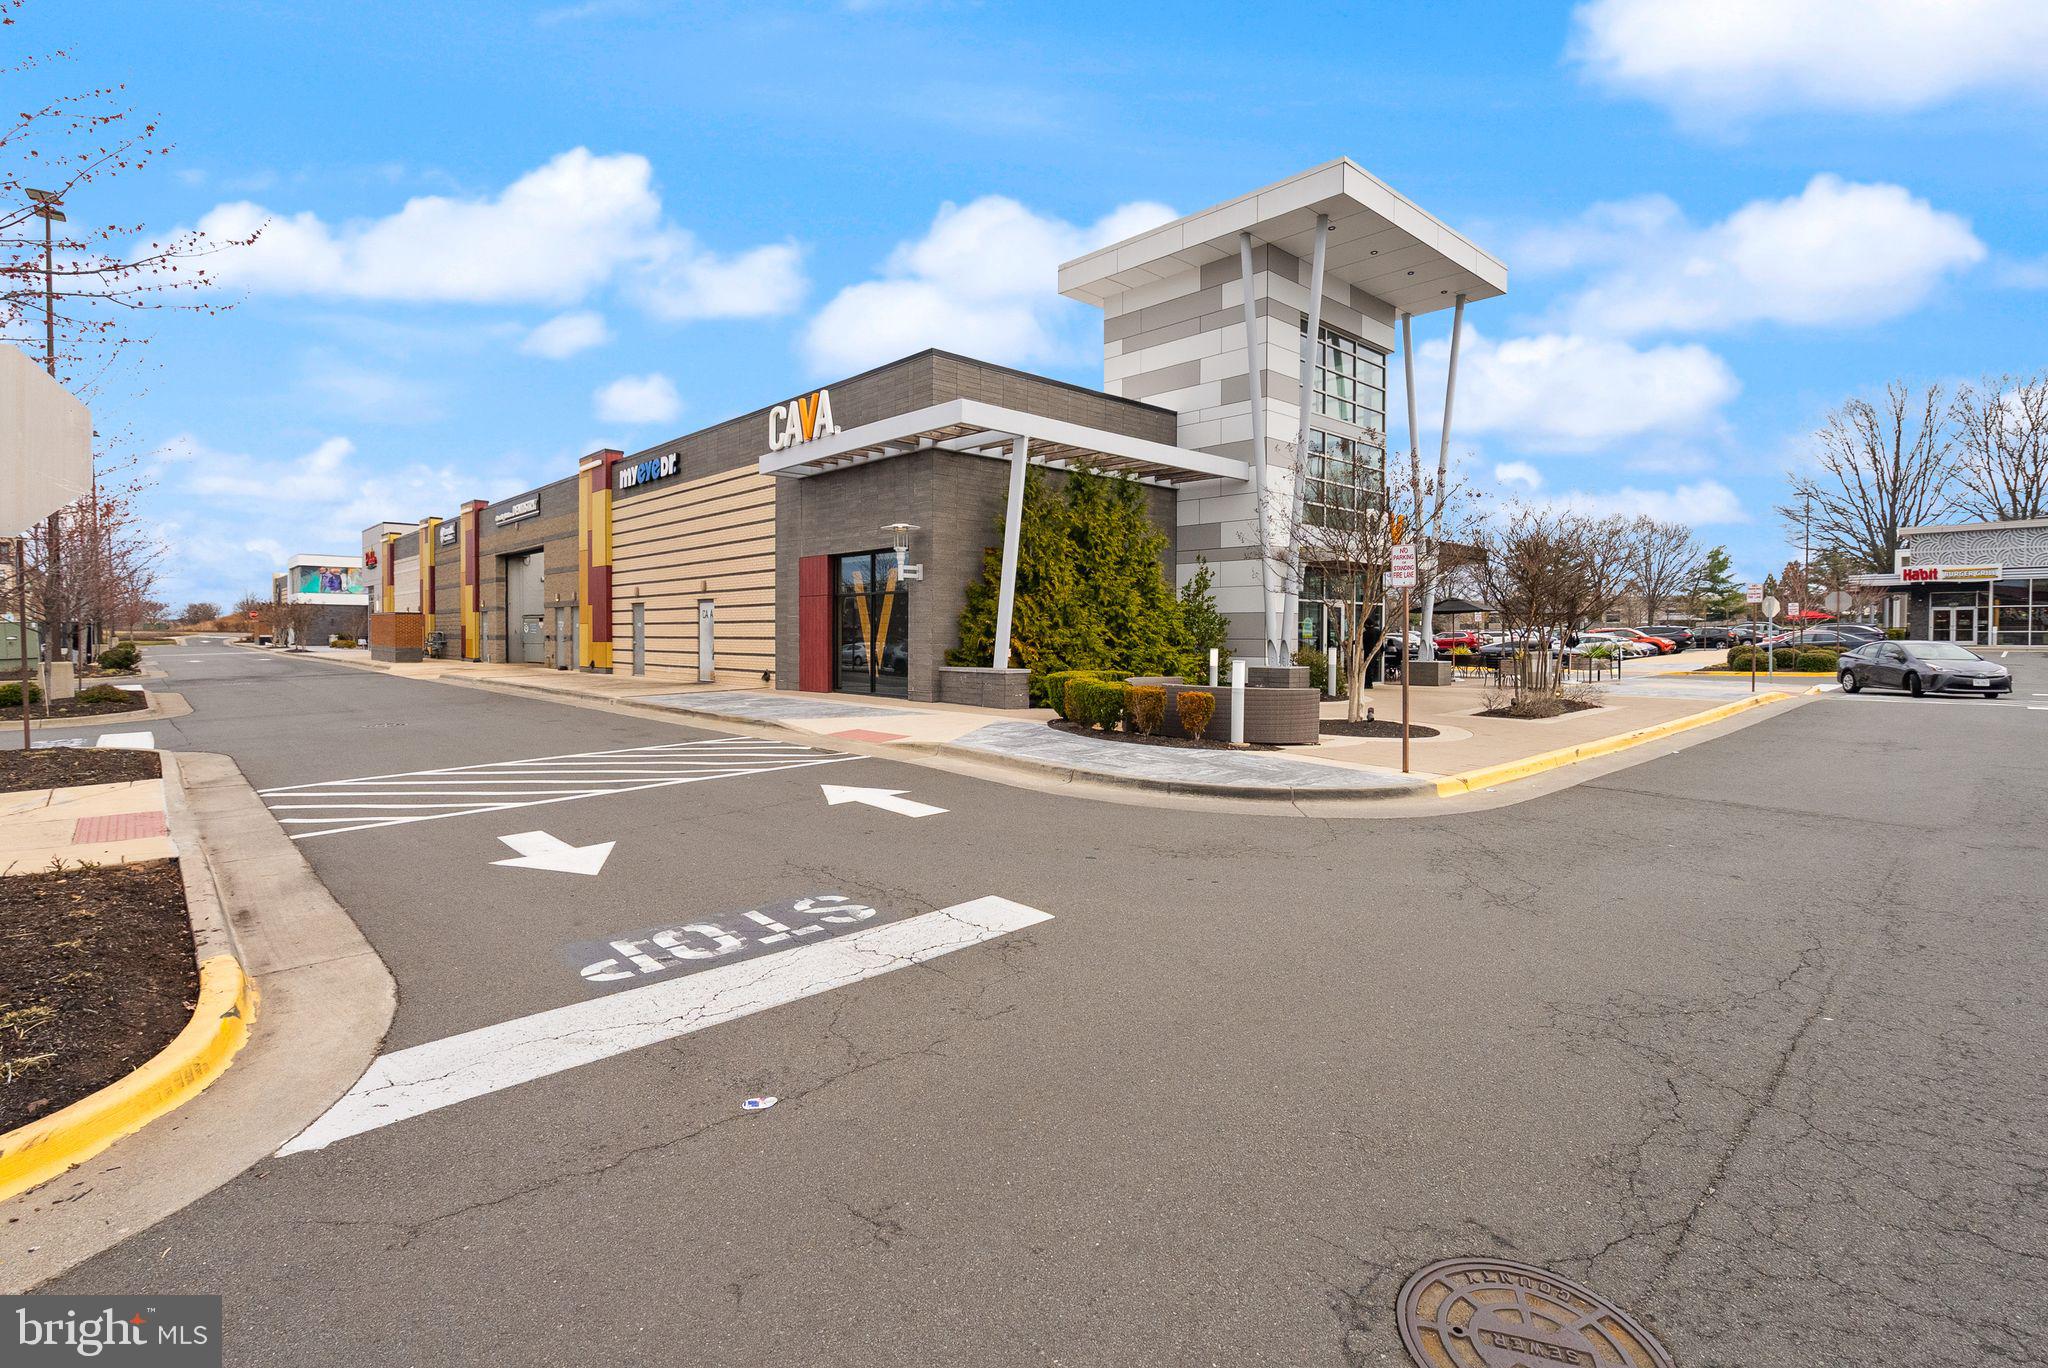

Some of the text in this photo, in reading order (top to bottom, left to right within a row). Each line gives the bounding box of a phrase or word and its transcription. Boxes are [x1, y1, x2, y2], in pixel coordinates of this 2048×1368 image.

[1903, 568, 1938, 580] Habit
[580, 895, 877, 982] STOP
[1465, 1271, 1571, 1302] COUNTY
[1492, 1332, 1582, 1364] SEWER
